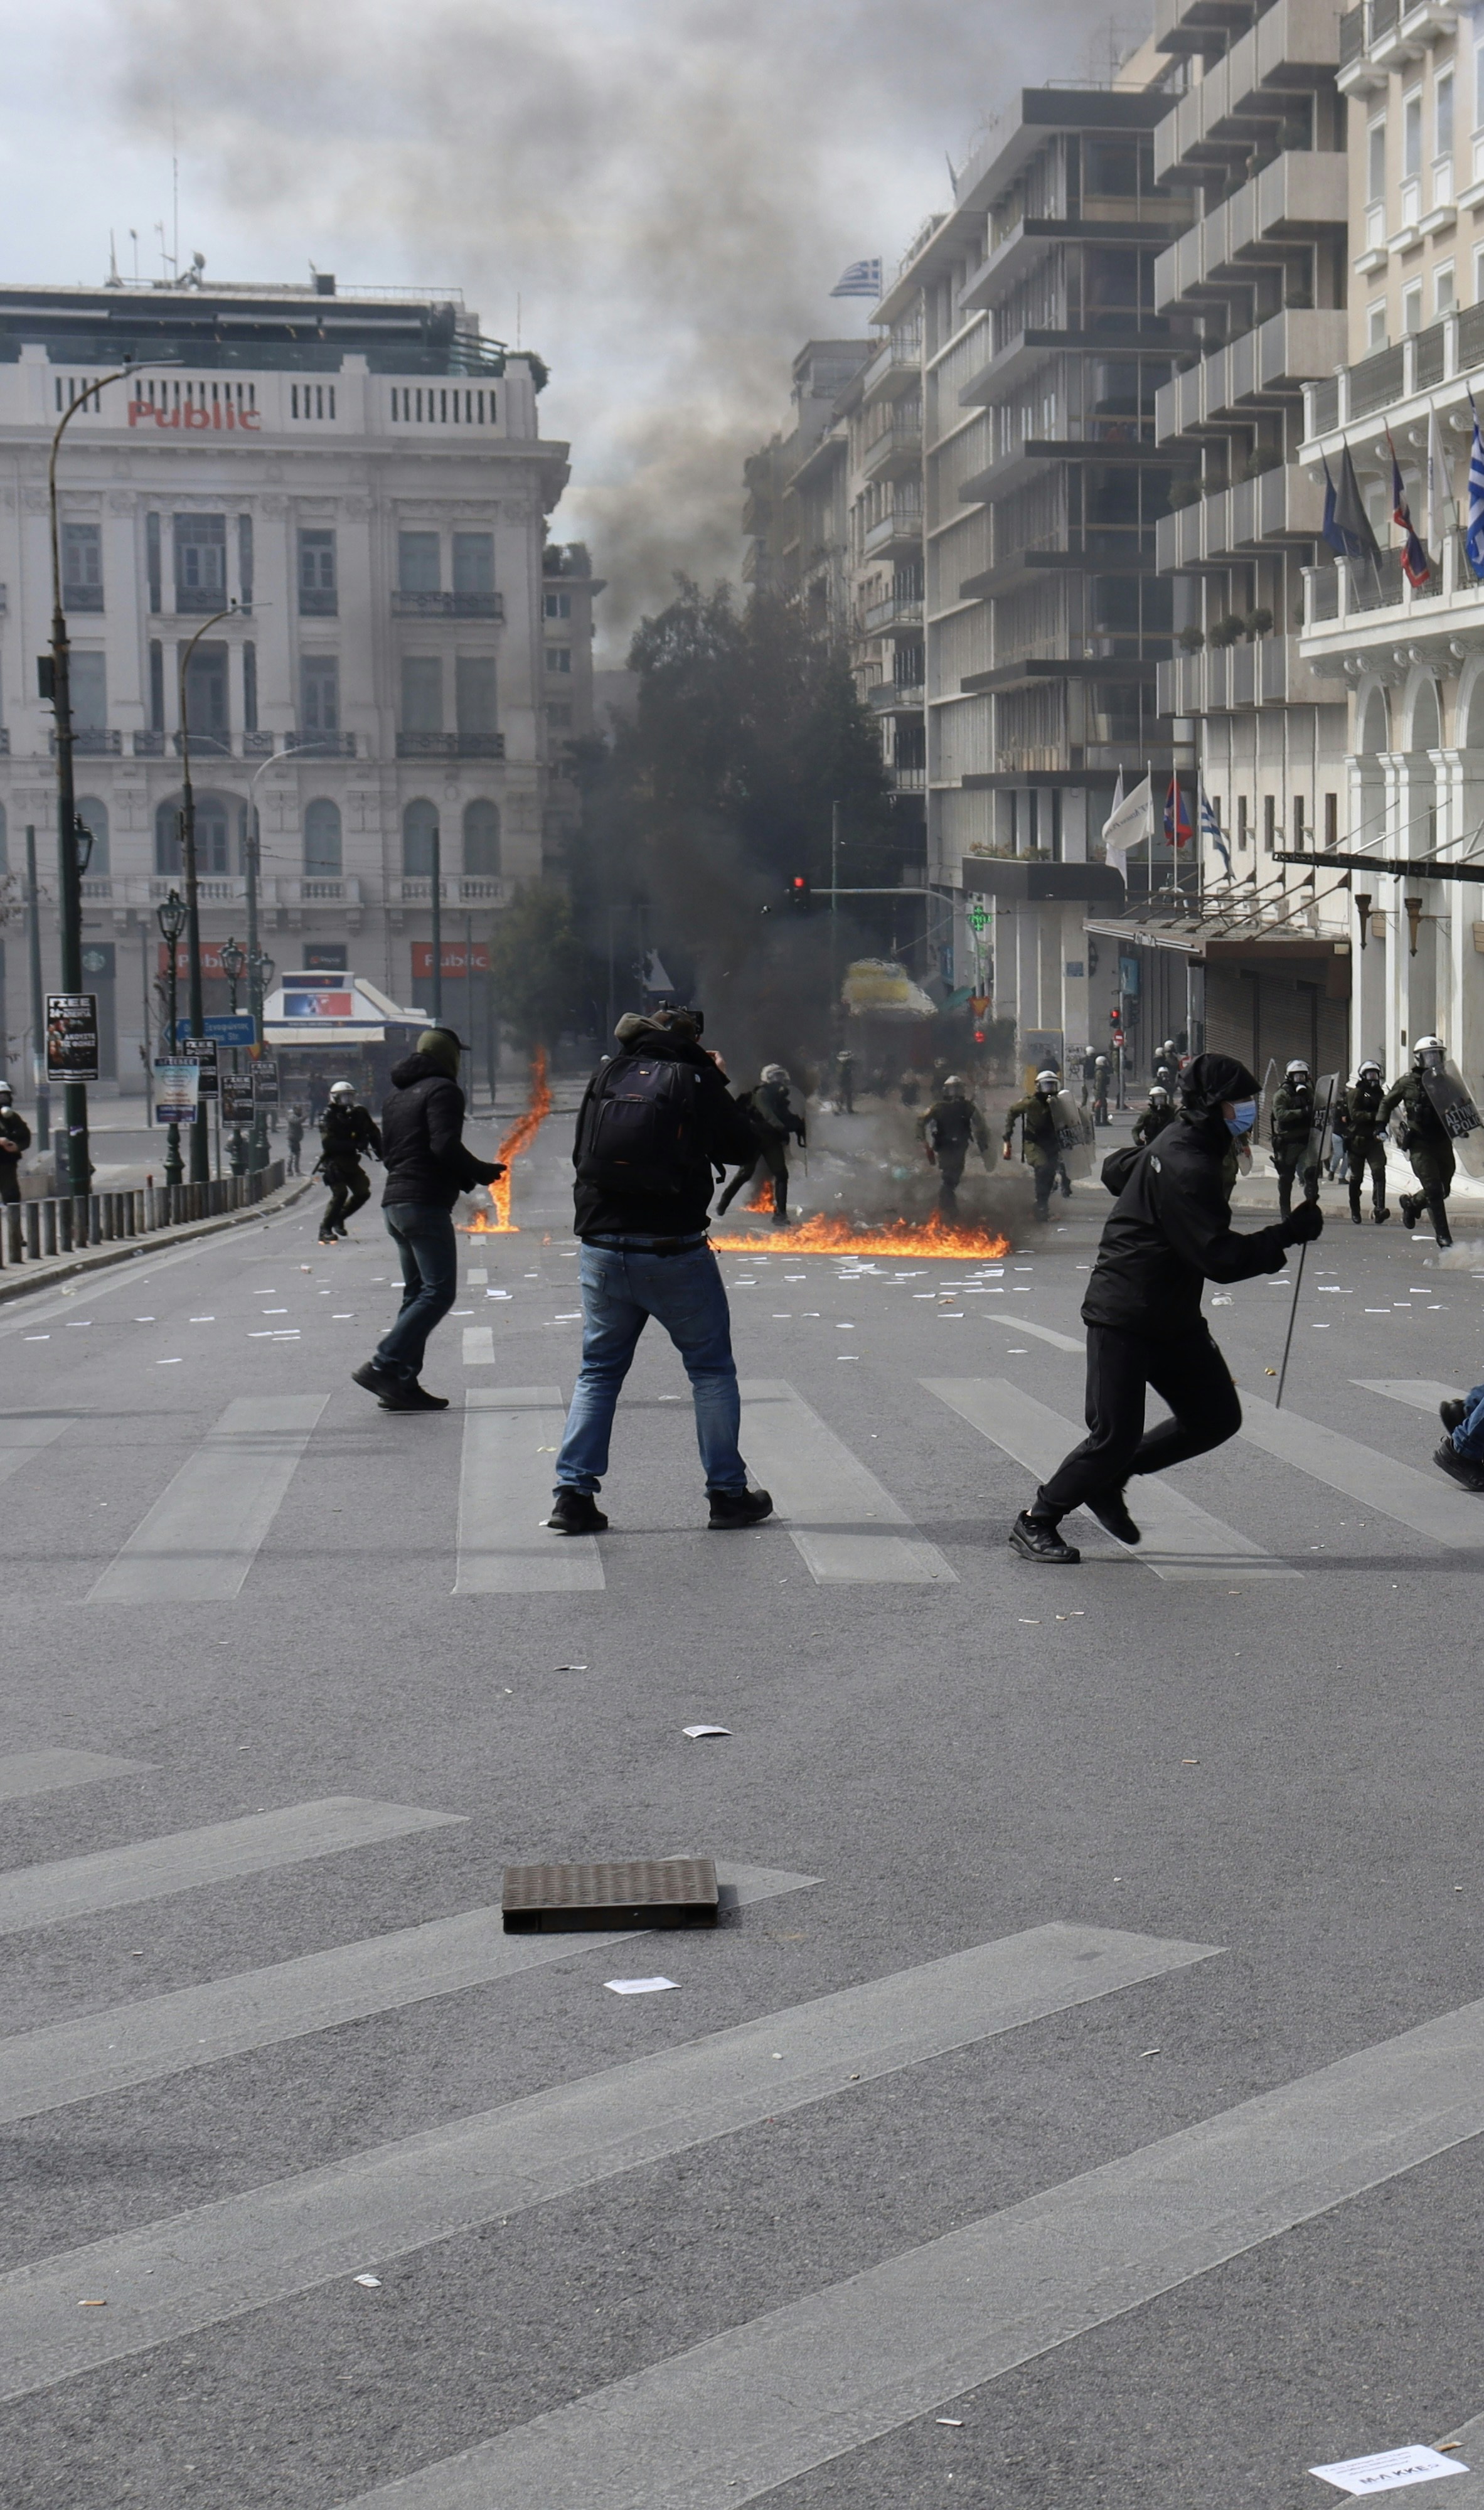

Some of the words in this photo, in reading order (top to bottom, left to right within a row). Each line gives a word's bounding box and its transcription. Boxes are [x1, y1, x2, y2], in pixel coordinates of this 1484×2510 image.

[128, 400, 261, 431] Public
[49, 998, 90, 1007] ΓΣΕΕ
[1452, 1115, 1481, 1135] POLIC
